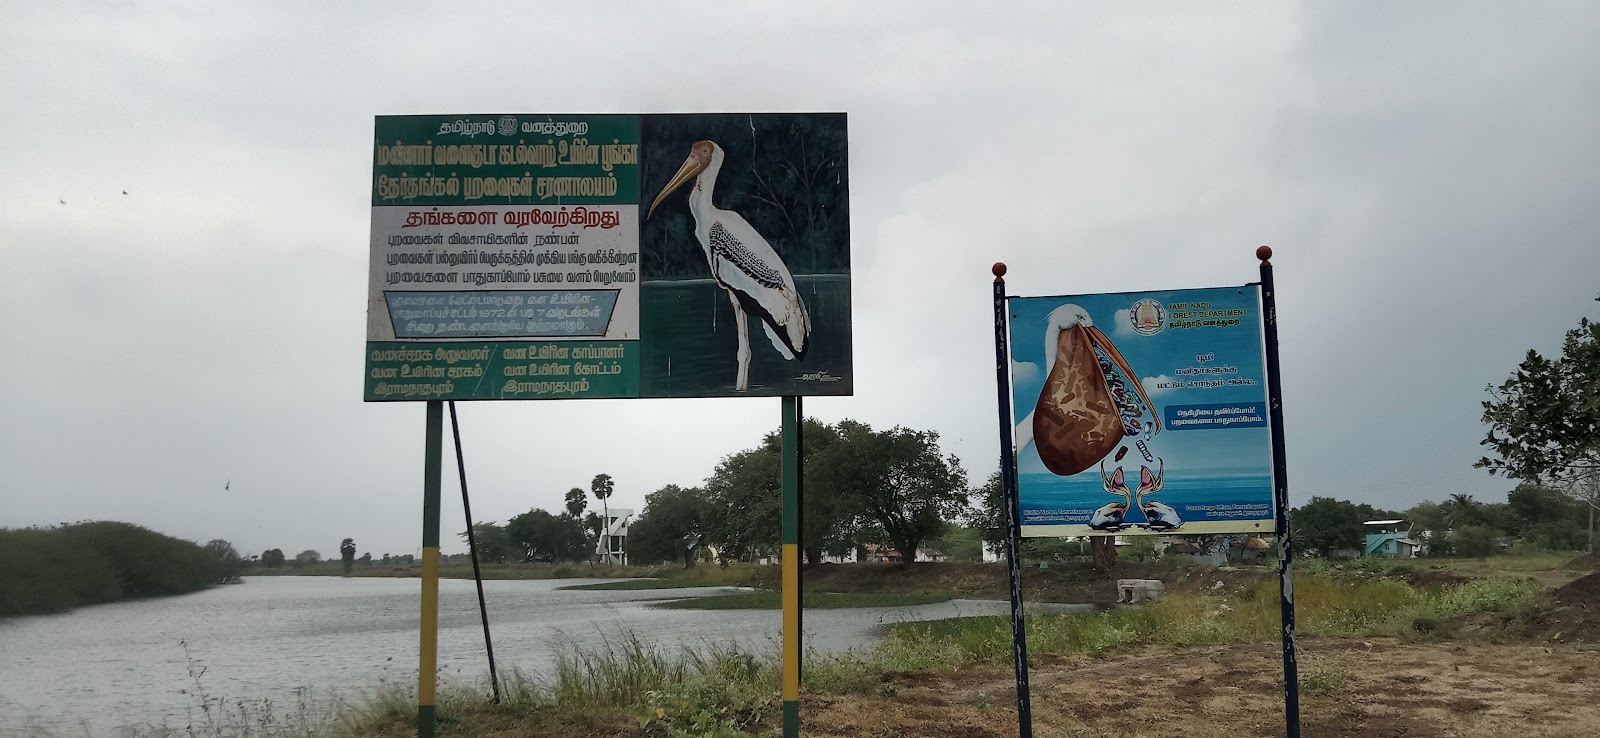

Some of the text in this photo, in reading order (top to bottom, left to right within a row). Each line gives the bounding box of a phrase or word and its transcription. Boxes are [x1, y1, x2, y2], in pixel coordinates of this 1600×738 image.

[437, 118, 589, 138] தமிழ்நாடு வனத்துறை
[378, 137, 638, 171] மன்னார் வளைகுடா கடல்வாழ் உயிரின பூங்கா
[378, 172, 618, 200] தேர்தங்கல் பறவைகள் சரணாலயம்
[402, 207, 621, 229] தங்களை வரவேற்கிறது
[387, 231, 580, 248] பறவைகள் விவசாயிகளின் நண்பன்
[386, 250, 434, 267] பறவைகள்
[386, 269, 636, 286] பறவைகளை பாதுகாப்போம் பசுமை வளம் பெறுவோம்
[1169, 301, 1211, 310] TAMIL NADU
[1169, 309, 1248, 319] FOREST DEPARTMENT
[371, 345, 490, 364] வனச்சரக அலுவலர்
[503, 344, 625, 360] வன உயிரின காப்பாளர்
[371, 363, 484, 379] வன உயிரின சரகம்
[504, 360, 622, 376] வன உயிரின கோட்டம்
[374, 380, 454, 396] இராமநாதபுரம்
[503, 378, 590, 396] இராமநாதபுரம்
